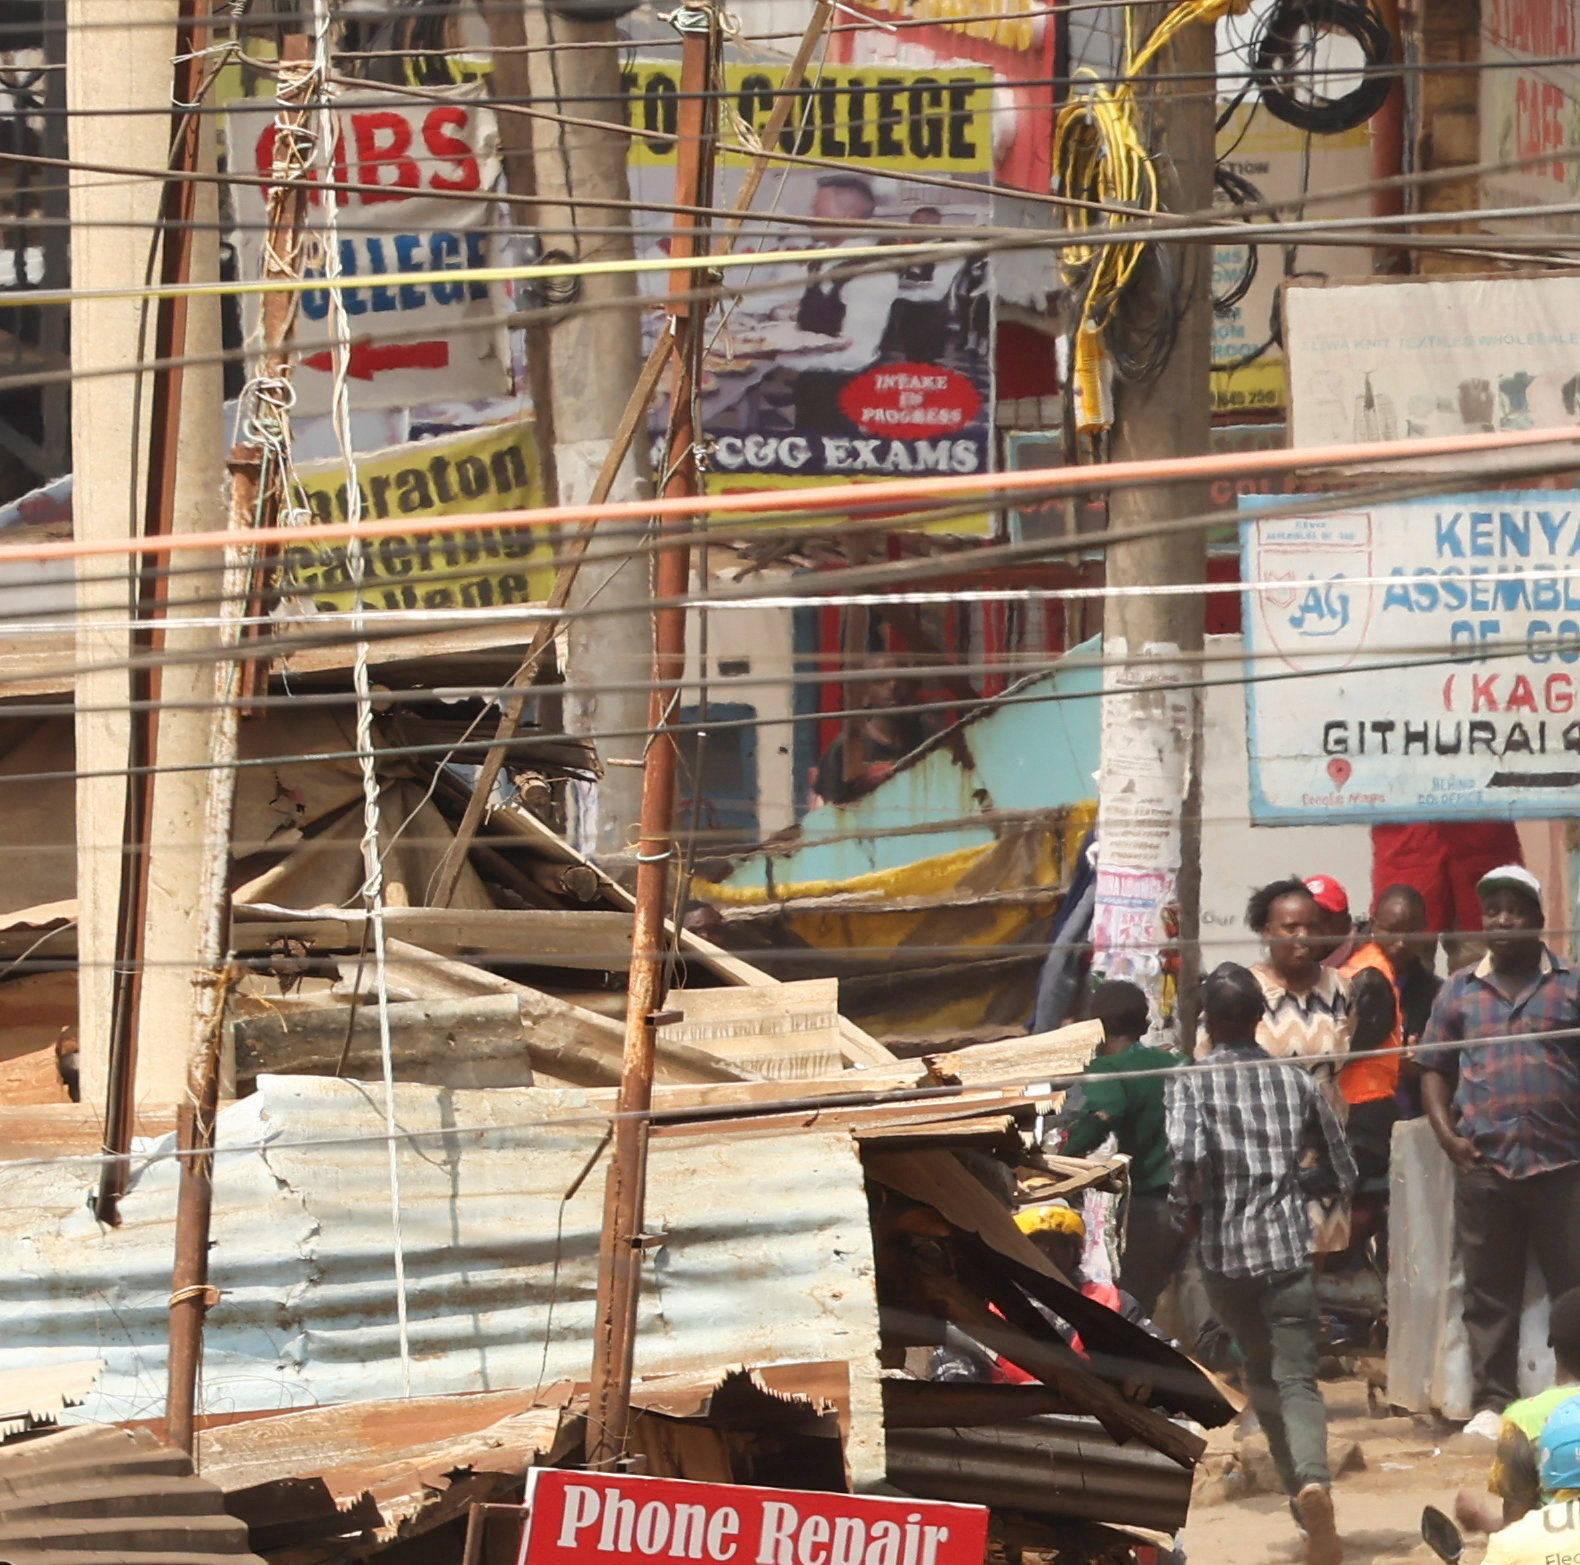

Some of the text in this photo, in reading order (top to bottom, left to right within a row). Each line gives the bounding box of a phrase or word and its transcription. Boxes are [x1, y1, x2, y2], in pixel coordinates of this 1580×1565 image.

[737, 76, 976, 160] COLLEGE
[301, 231, 488, 321] OLLEGE
[861, 406, 963, 425] PROGRESS
[293, 445, 529, 524] heraton
[822, 436, 979, 473] EXAMS
[1450, 620, 1501, 665] OF
[1322, 720, 1548, 756] GITHURAI
[556, 1482, 739, 1562] Phone
